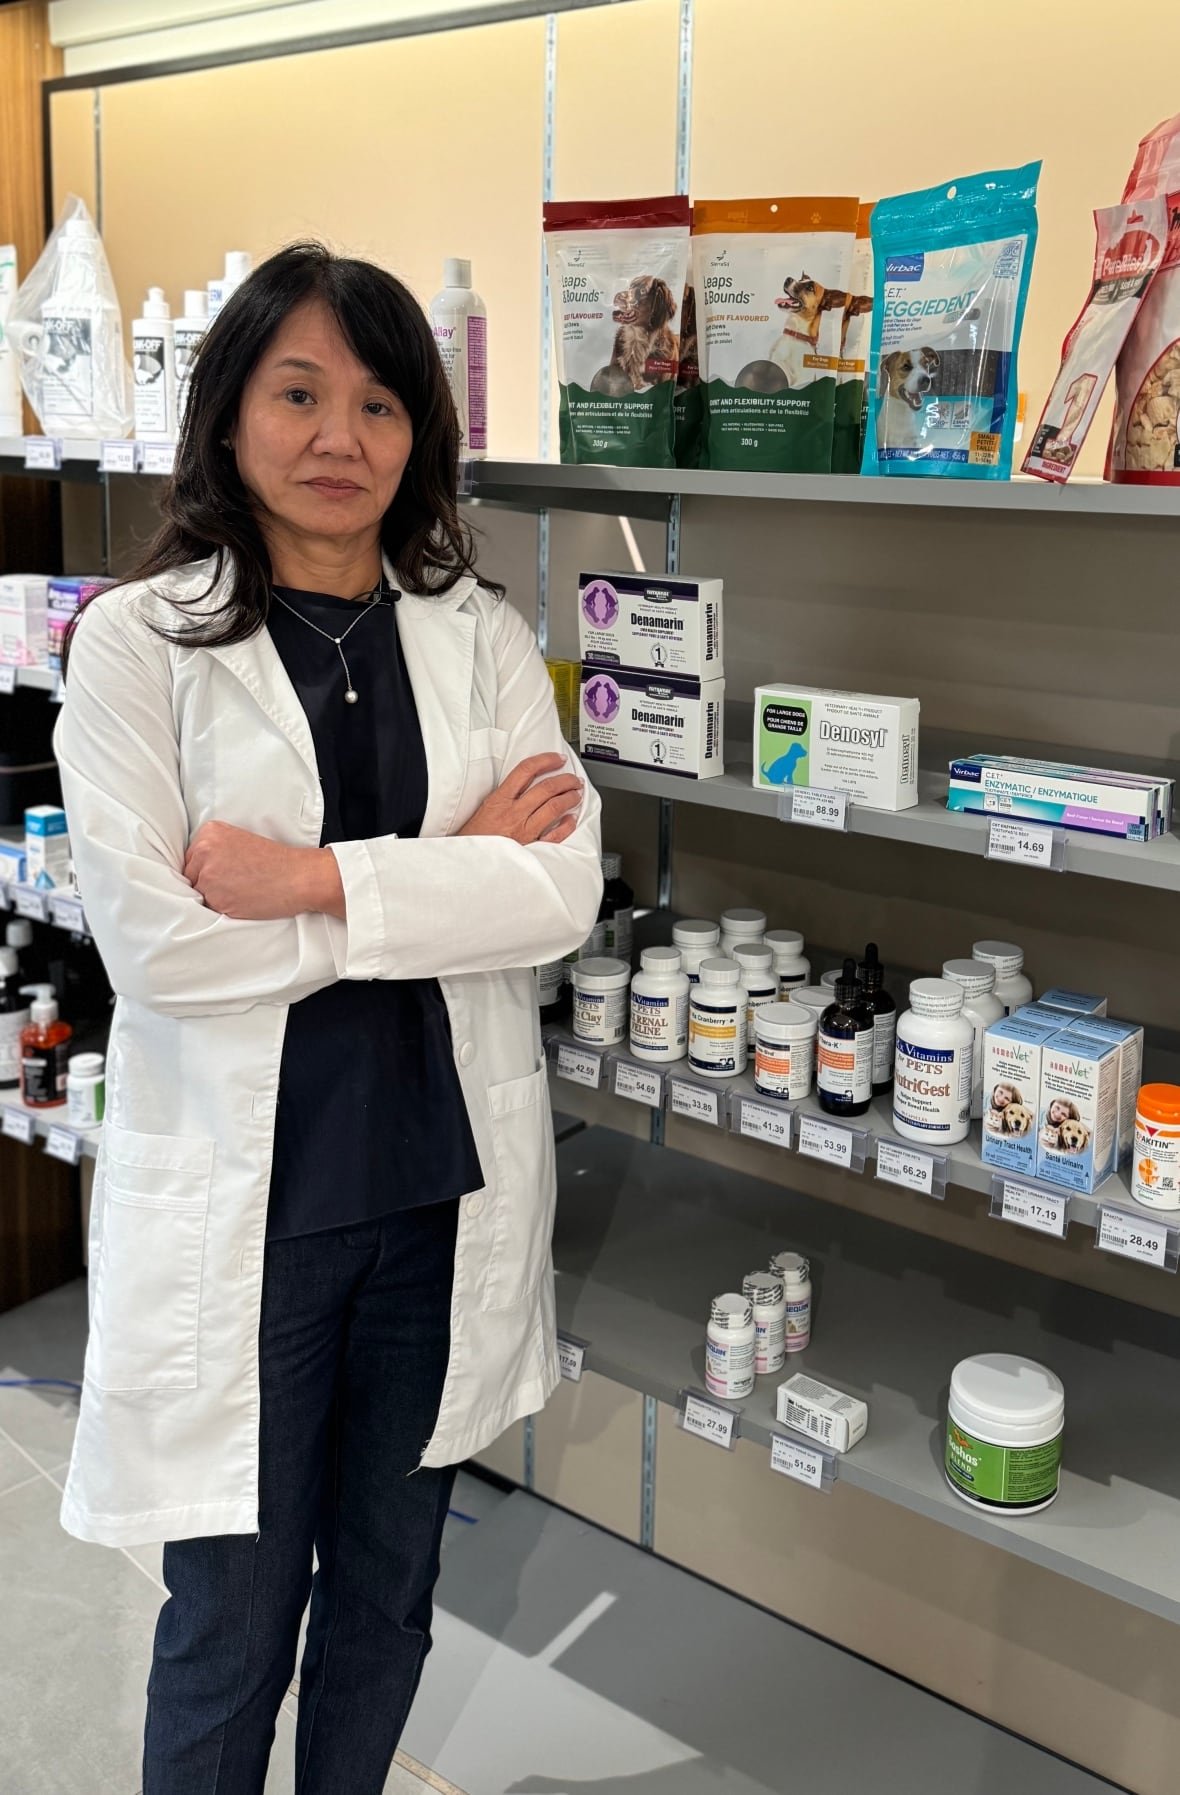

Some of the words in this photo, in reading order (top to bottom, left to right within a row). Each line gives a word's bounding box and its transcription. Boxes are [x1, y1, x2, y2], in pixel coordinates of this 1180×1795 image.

[704, 276, 733, 290] Leaps
[709, 291, 750, 304] Bounds
[884, 290, 976, 317] EGGIEDENT
[734, 398, 775, 407] FLEXIBILITY
[776, 400, 811, 408] SUPPORT
[741, 438, 753, 446] 300
[631, 612, 684, 630] Denamarin
[705, 602, 713, 661] Denamarin
[631, 708, 685, 728] Denamarin
[780, 718, 797, 726] CHIENS
[705, 701, 714, 759] Denamarin
[768, 723, 787, 731] GRANDE
[820, 720, 885, 748] Denosyl
[953, 767, 980, 778] Virbac
[984, 780, 1031, 793] ENZYMATIC
[1033, 786, 1037, 794] /
[1038, 787, 1099, 804] ENZYMATIQUE
[816, 805, 839, 817] 88.99
[1000, 823, 1023, 831] ENZYMATIC
[1018, 840, 1044, 852] 14.69
[637, 993, 668, 1007] Vitamins
[638, 1005, 661, 1014] PETS
[581, 1011, 602, 1025] Clay
[637, 1016, 668, 1027] RENAL
[697, 1014, 725, 1025] Cranberry
[904, 1043, 953, 1062] Vitamins
[575, 1063, 595, 1076] 42.59
[906, 1058, 943, 1075] PETS
[636, 1081, 656, 1095] 54.69
[691, 1099, 712, 1113] 33.89
[911, 1095, 932, 1106] Support
[922, 1104, 940, 1113] Health
[762, 1120, 785, 1135] 41.39
[824, 1139, 847, 1154] 53.99
[985, 1134, 1003, 1148] Urinary
[1004, 1139, 1016, 1150] Tract
[1016, 1143, 1033, 1154] Health
[1136, 1130, 1169, 1149] EAKITIN
[1045, 1151, 1061, 1163] Santé
[1061, 1157, 1084, 1170] Urinaire
[902, 1164, 927, 1180] 66.29
[1030, 1205, 1057, 1221] 17.19
[1129, 1234, 1159, 1251] 28.49
[706, 1418, 728, 1434] 27.99
[794, 1458, 816, 1475] 51.59
